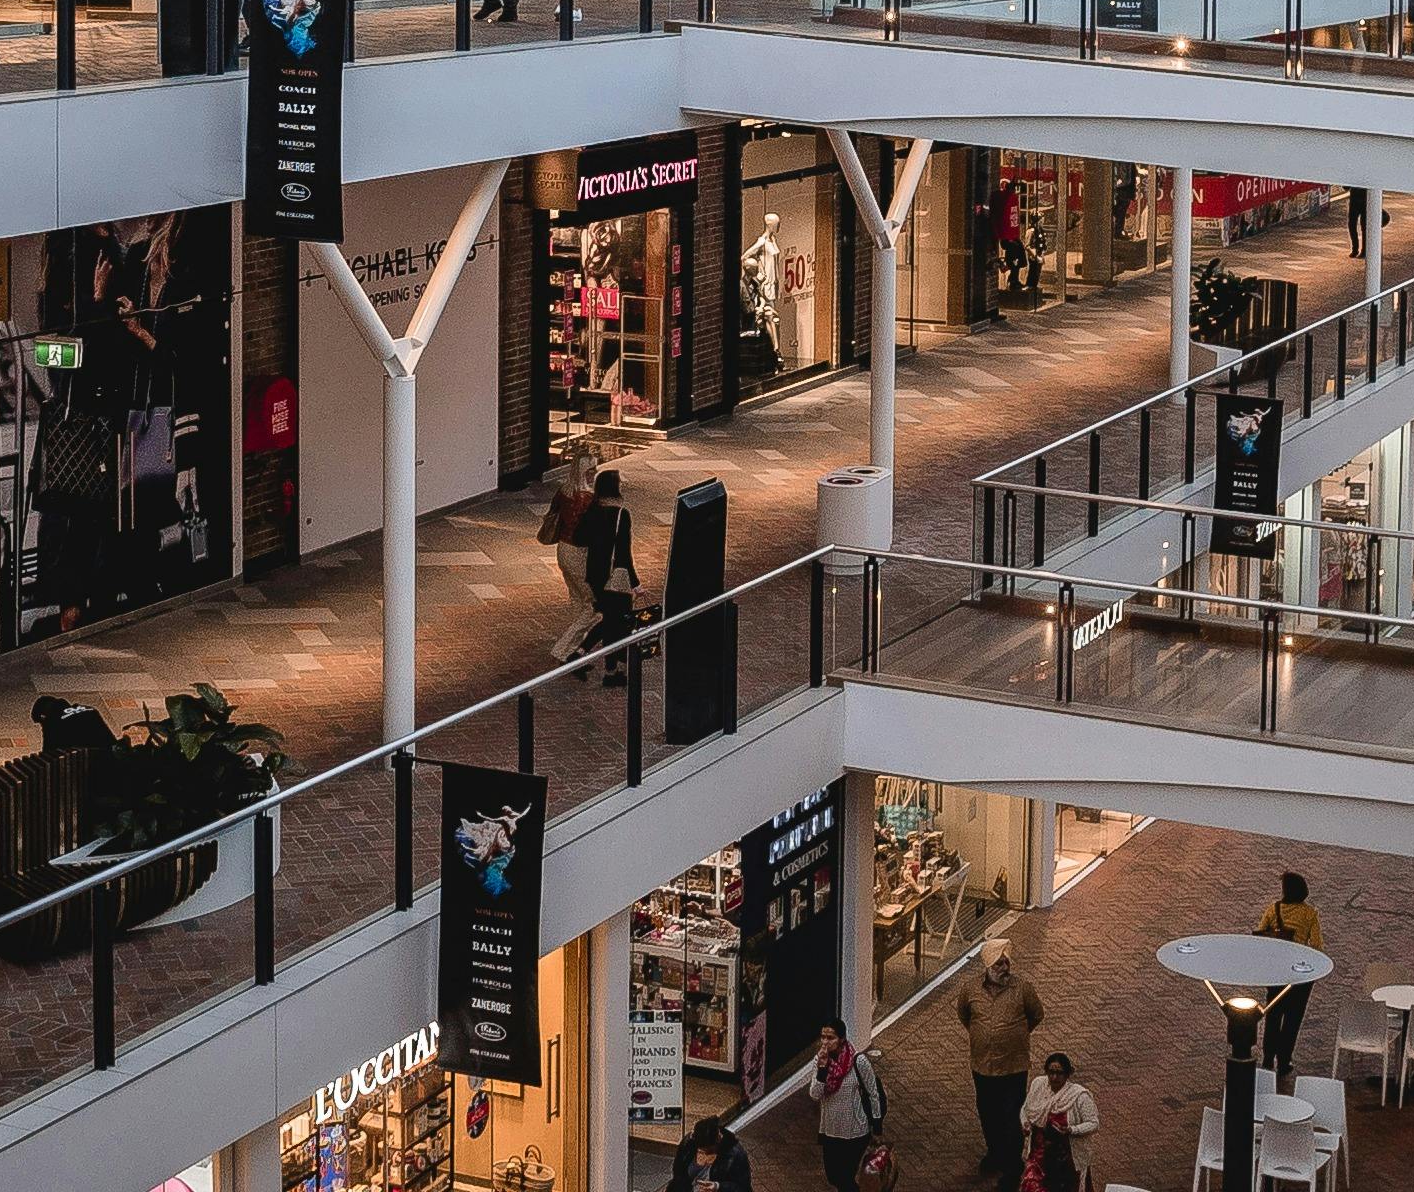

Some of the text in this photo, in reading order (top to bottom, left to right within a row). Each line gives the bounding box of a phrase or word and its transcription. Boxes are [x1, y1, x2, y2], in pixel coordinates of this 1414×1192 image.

[278, 84, 316, 95] COACH
[278, 102, 316, 115] BALLY
[651, 158, 698, 187] SECRET
[1233, 480, 1258, 489] BALLY
[782, 840, 829, 881] COSMETICS
[472, 924, 512, 937] COACH
[472, 941, 512, 956] BALLY
[471, 997, 512, 1014] ZANEROBE
[633, 1047, 677, 1056] BRANDS
[316, 1020, 440, 1125] L'OCCITAN
[636, 1068, 650, 1076] TO
[652, 1068, 677, 1077] FIND
[628, 1079, 673, 1088] GRANCES
